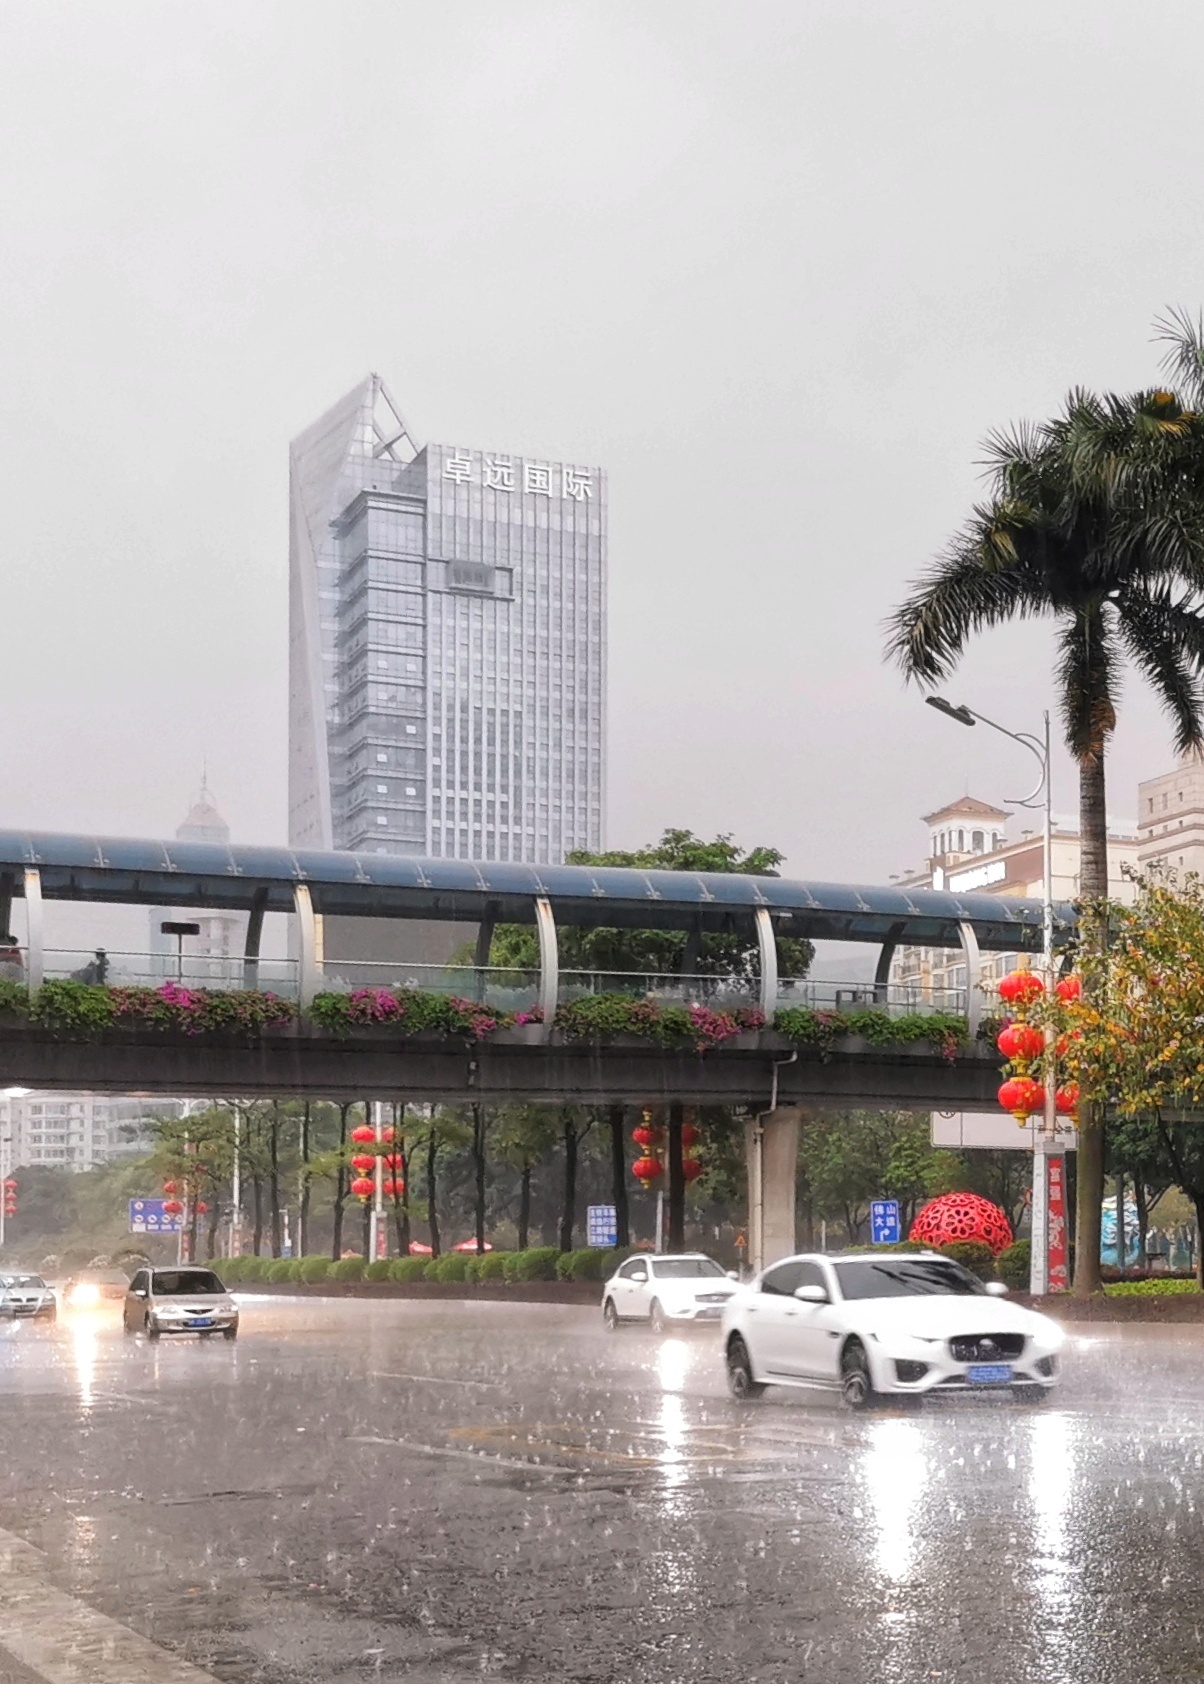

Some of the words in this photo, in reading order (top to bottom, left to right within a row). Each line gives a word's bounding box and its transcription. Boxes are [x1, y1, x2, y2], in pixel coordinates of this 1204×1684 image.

[442, 452, 593, 501] 卓远国际
[874, 1204, 896, 1215] 佛山
[874, 1216, 896, 1227] 大道
